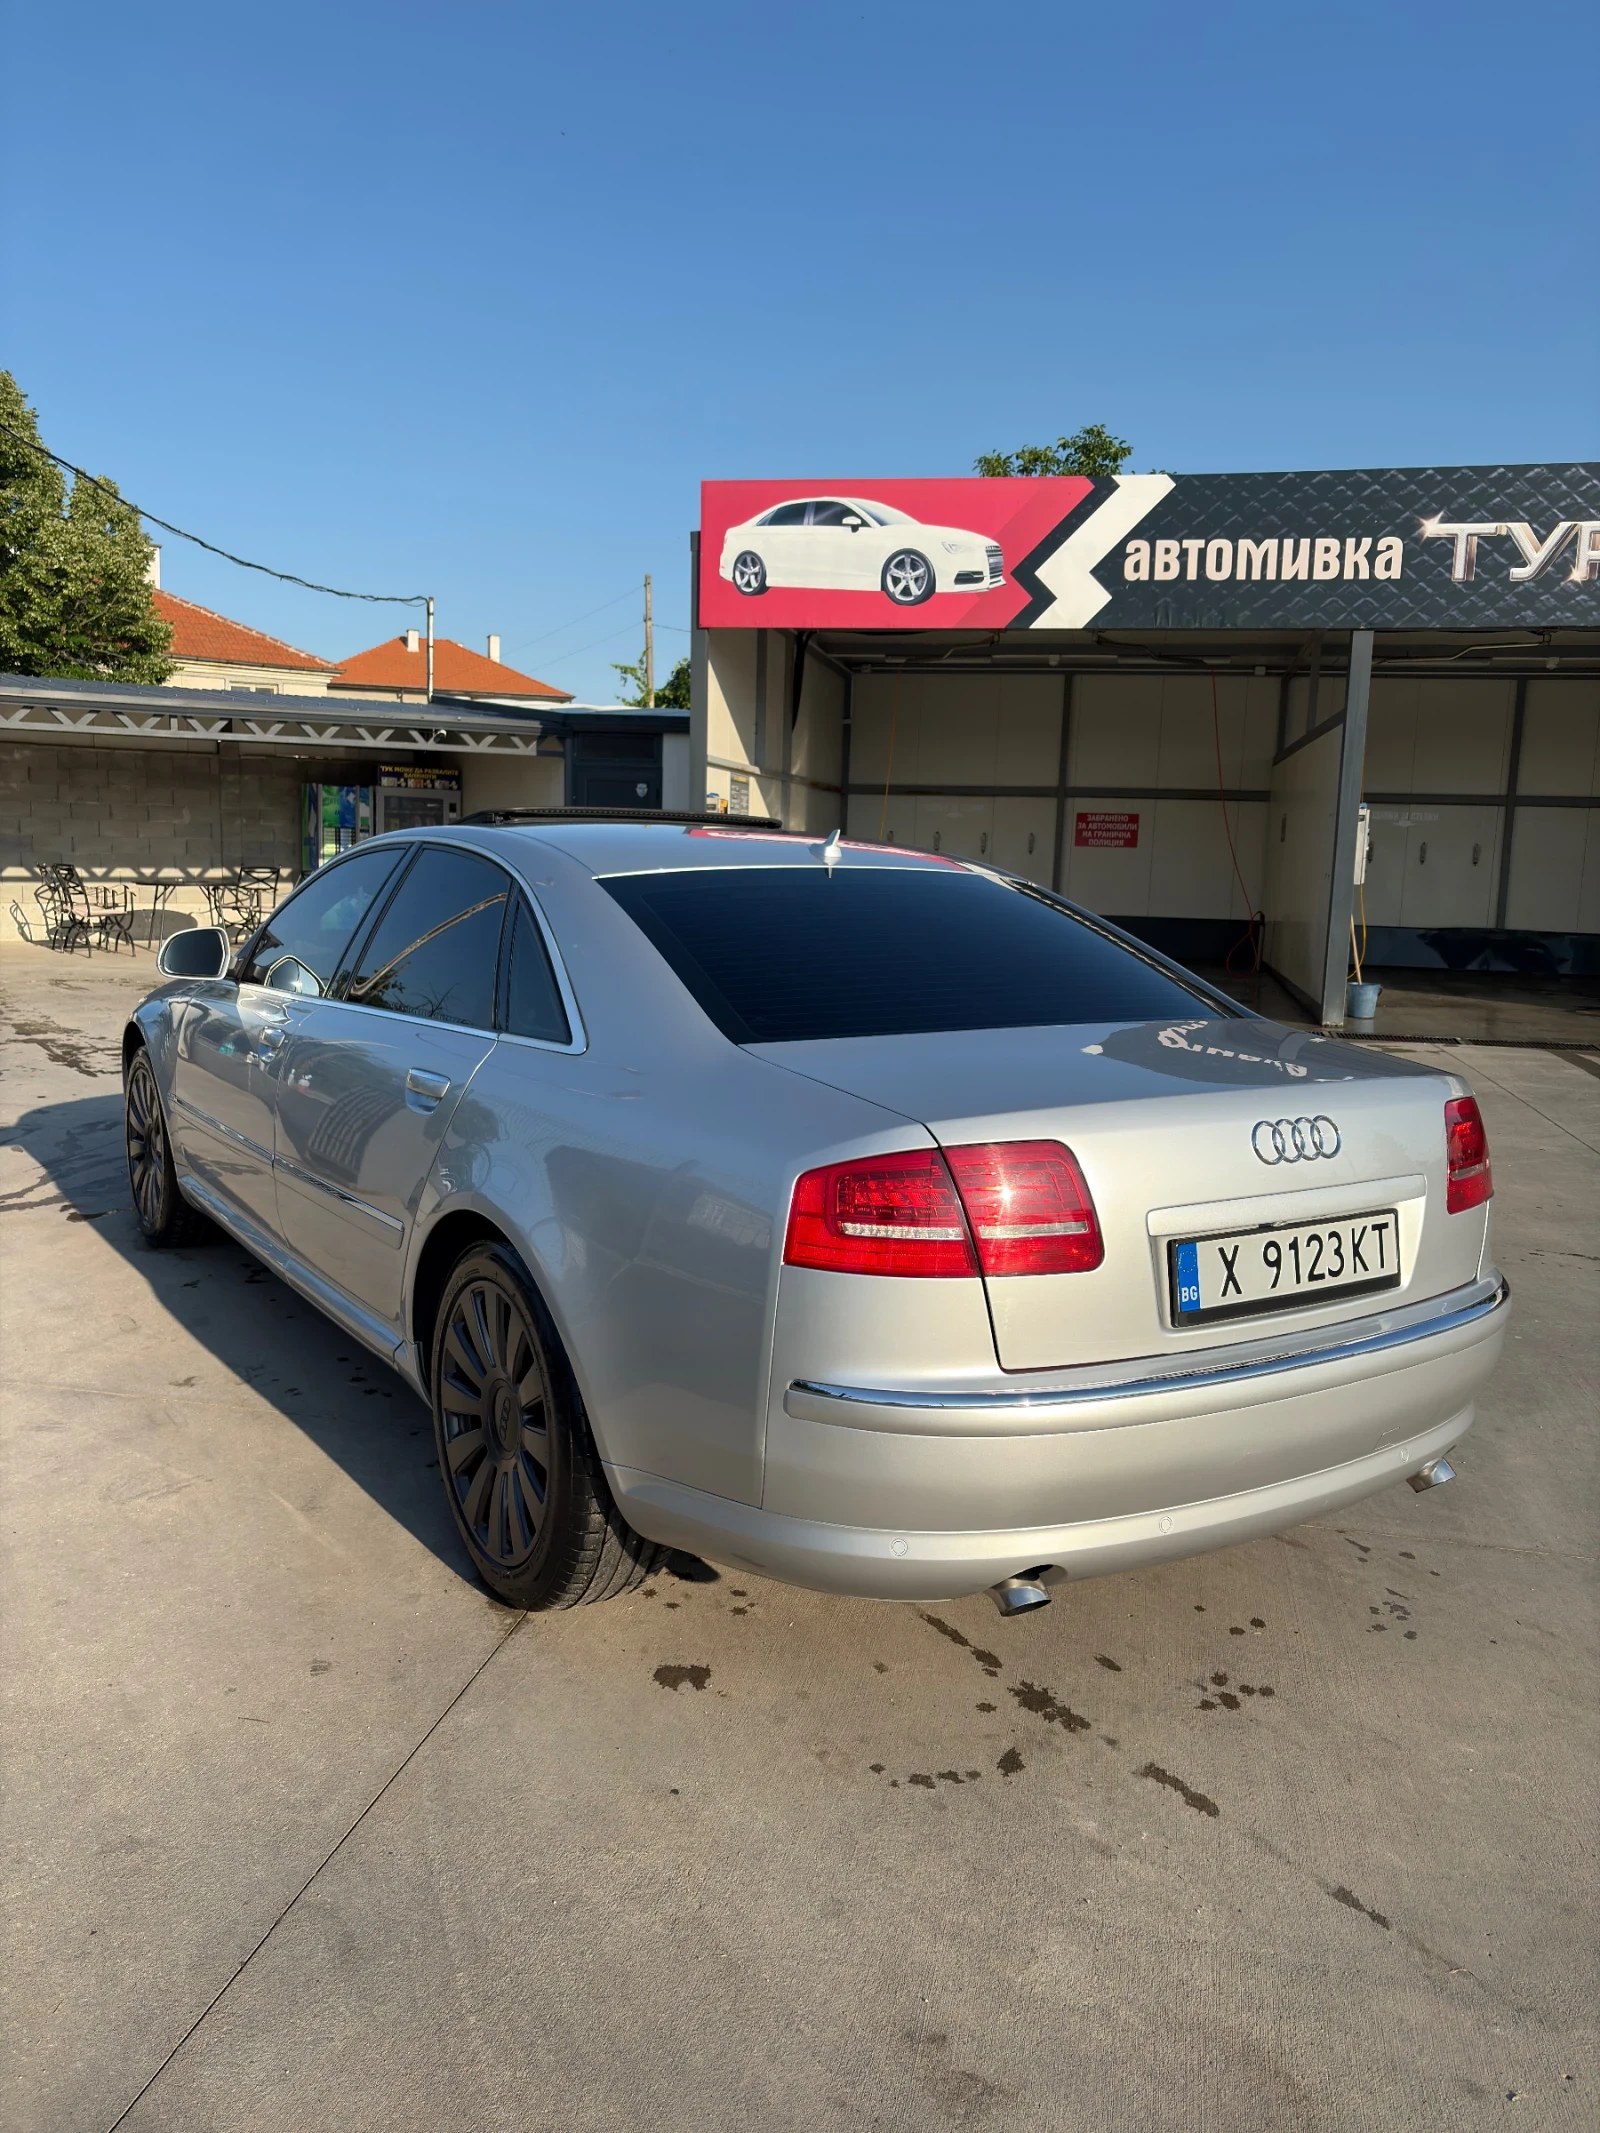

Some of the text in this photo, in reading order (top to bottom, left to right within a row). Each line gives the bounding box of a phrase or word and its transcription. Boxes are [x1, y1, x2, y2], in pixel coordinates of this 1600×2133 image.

[380, 765, 393, 773] ТУК
[394, 766, 413, 774] МОЖЕ
[1088, 823, 1137, 831] АВТОМОБИЛИ
[1082, 830, 1092, 838] НА
[1089, 839, 1124, 847] ПОЛИЦИЯ
[1217, 1245, 1243, 1297] X
[1181, 1286, 1198, 1302] BG
